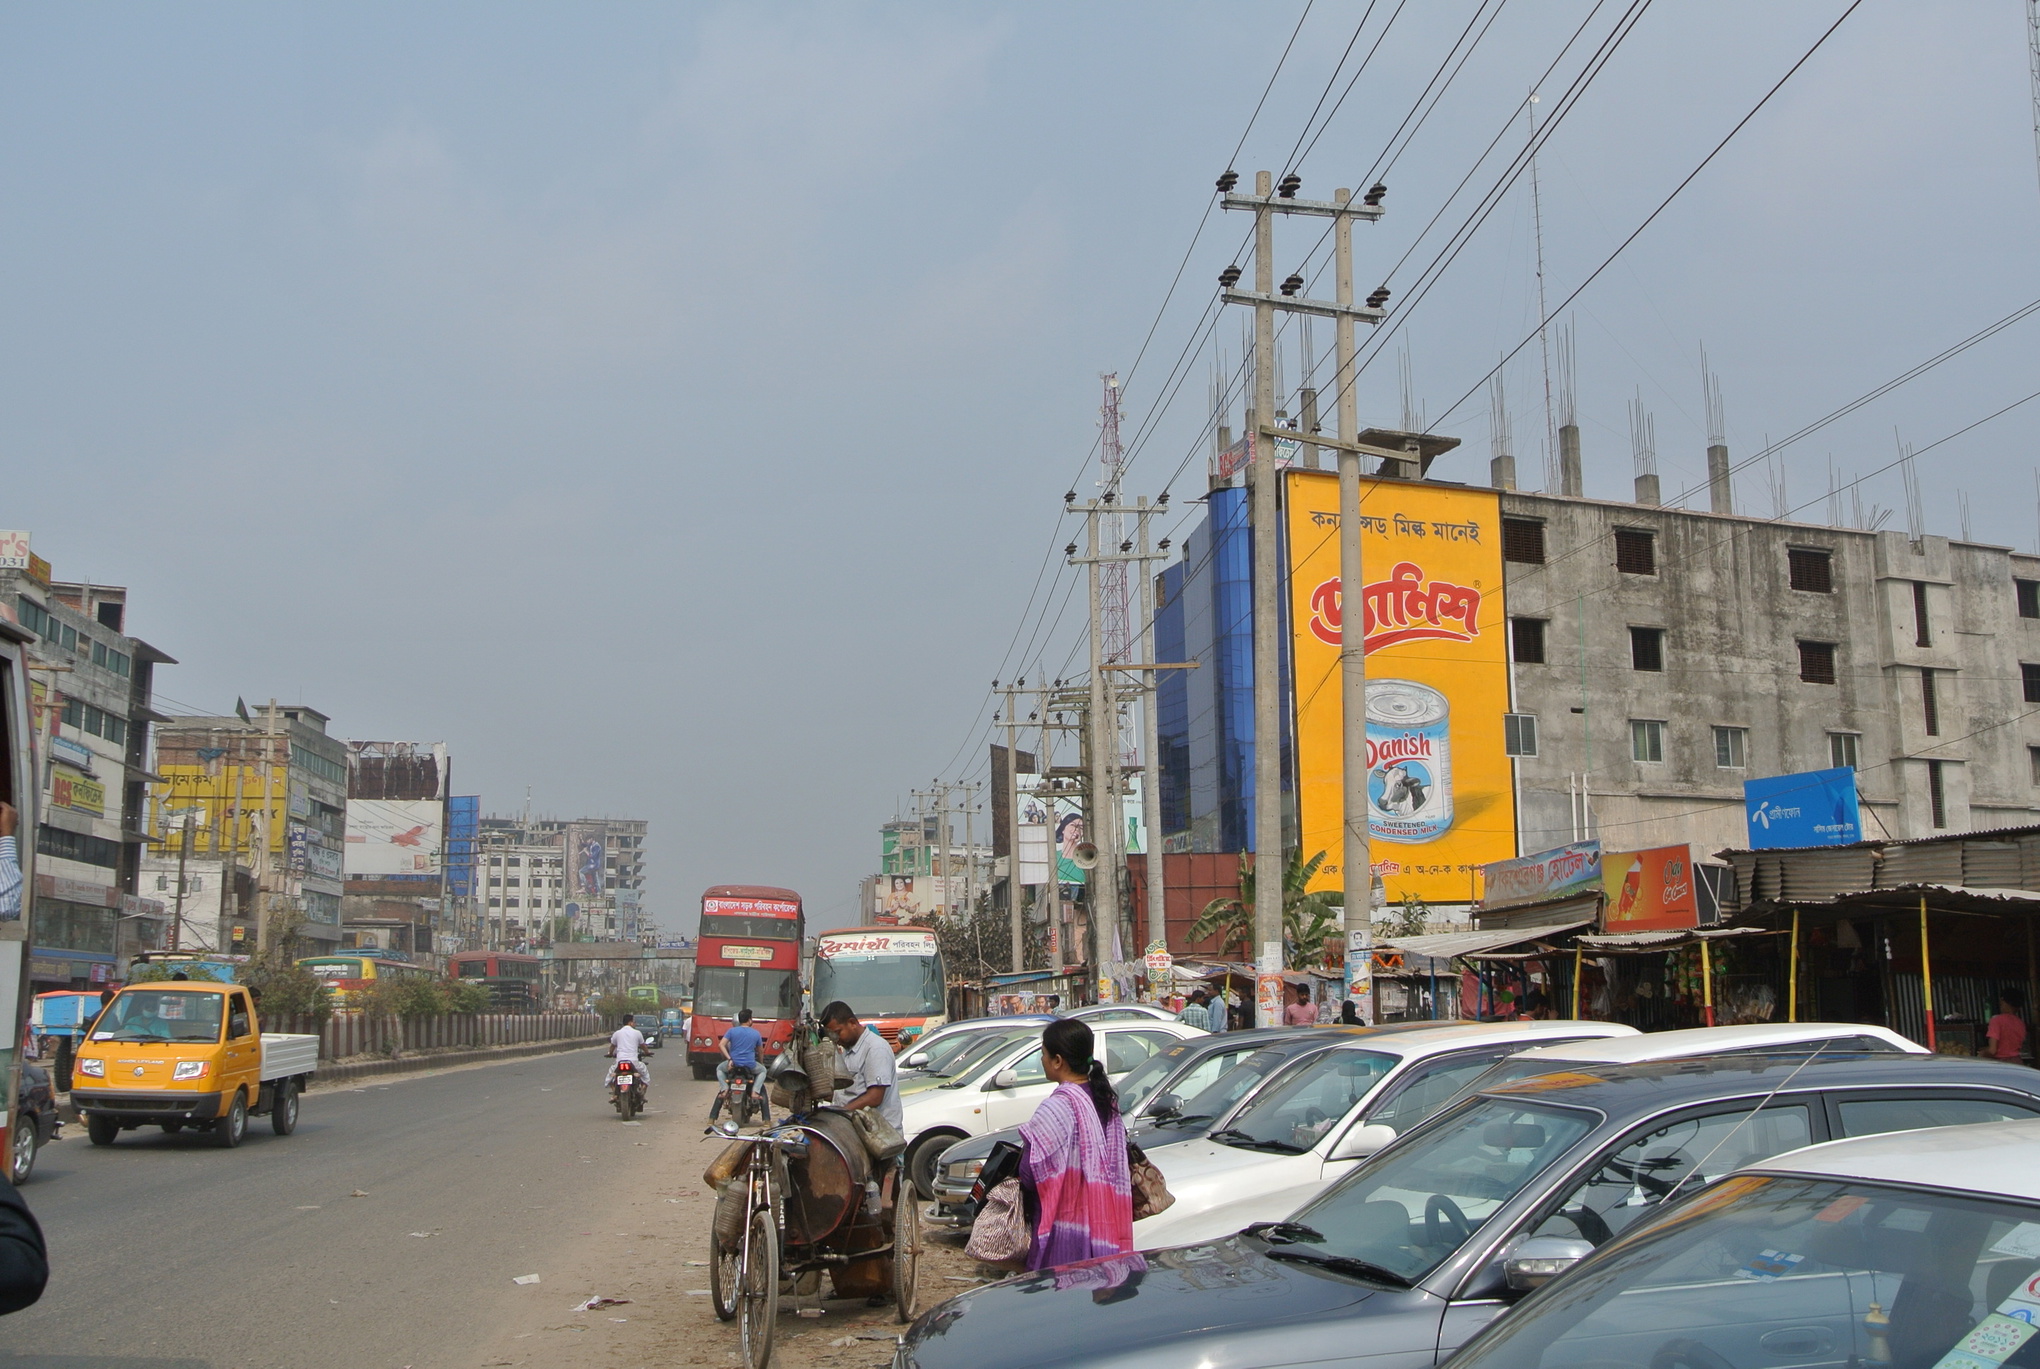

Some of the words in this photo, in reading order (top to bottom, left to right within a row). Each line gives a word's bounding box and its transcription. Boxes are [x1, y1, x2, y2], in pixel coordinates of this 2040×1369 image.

[1393, 513, 1426, 539] মিল্ক
[1431, 518, 1481, 545] মানেই
[1365, 732, 1431, 769] Danish
[1769, 805, 1800, 820] গ্রামীণফোন
[1370, 823, 1418, 836] CONDENSED
[1420, 824, 1438, 834] MILK
[1383, 821, 1426, 829] SWEETENED
[1322, 865, 1337, 875] এক
[1403, 865, 1411, 875] এ
[1548, 850, 1585, 883] হোটেল
[818, 937, 890, 958] বৈশাখী
[893, 940, 920, 948] পরিবহন
[923, 940, 934, 949] লিঃ
